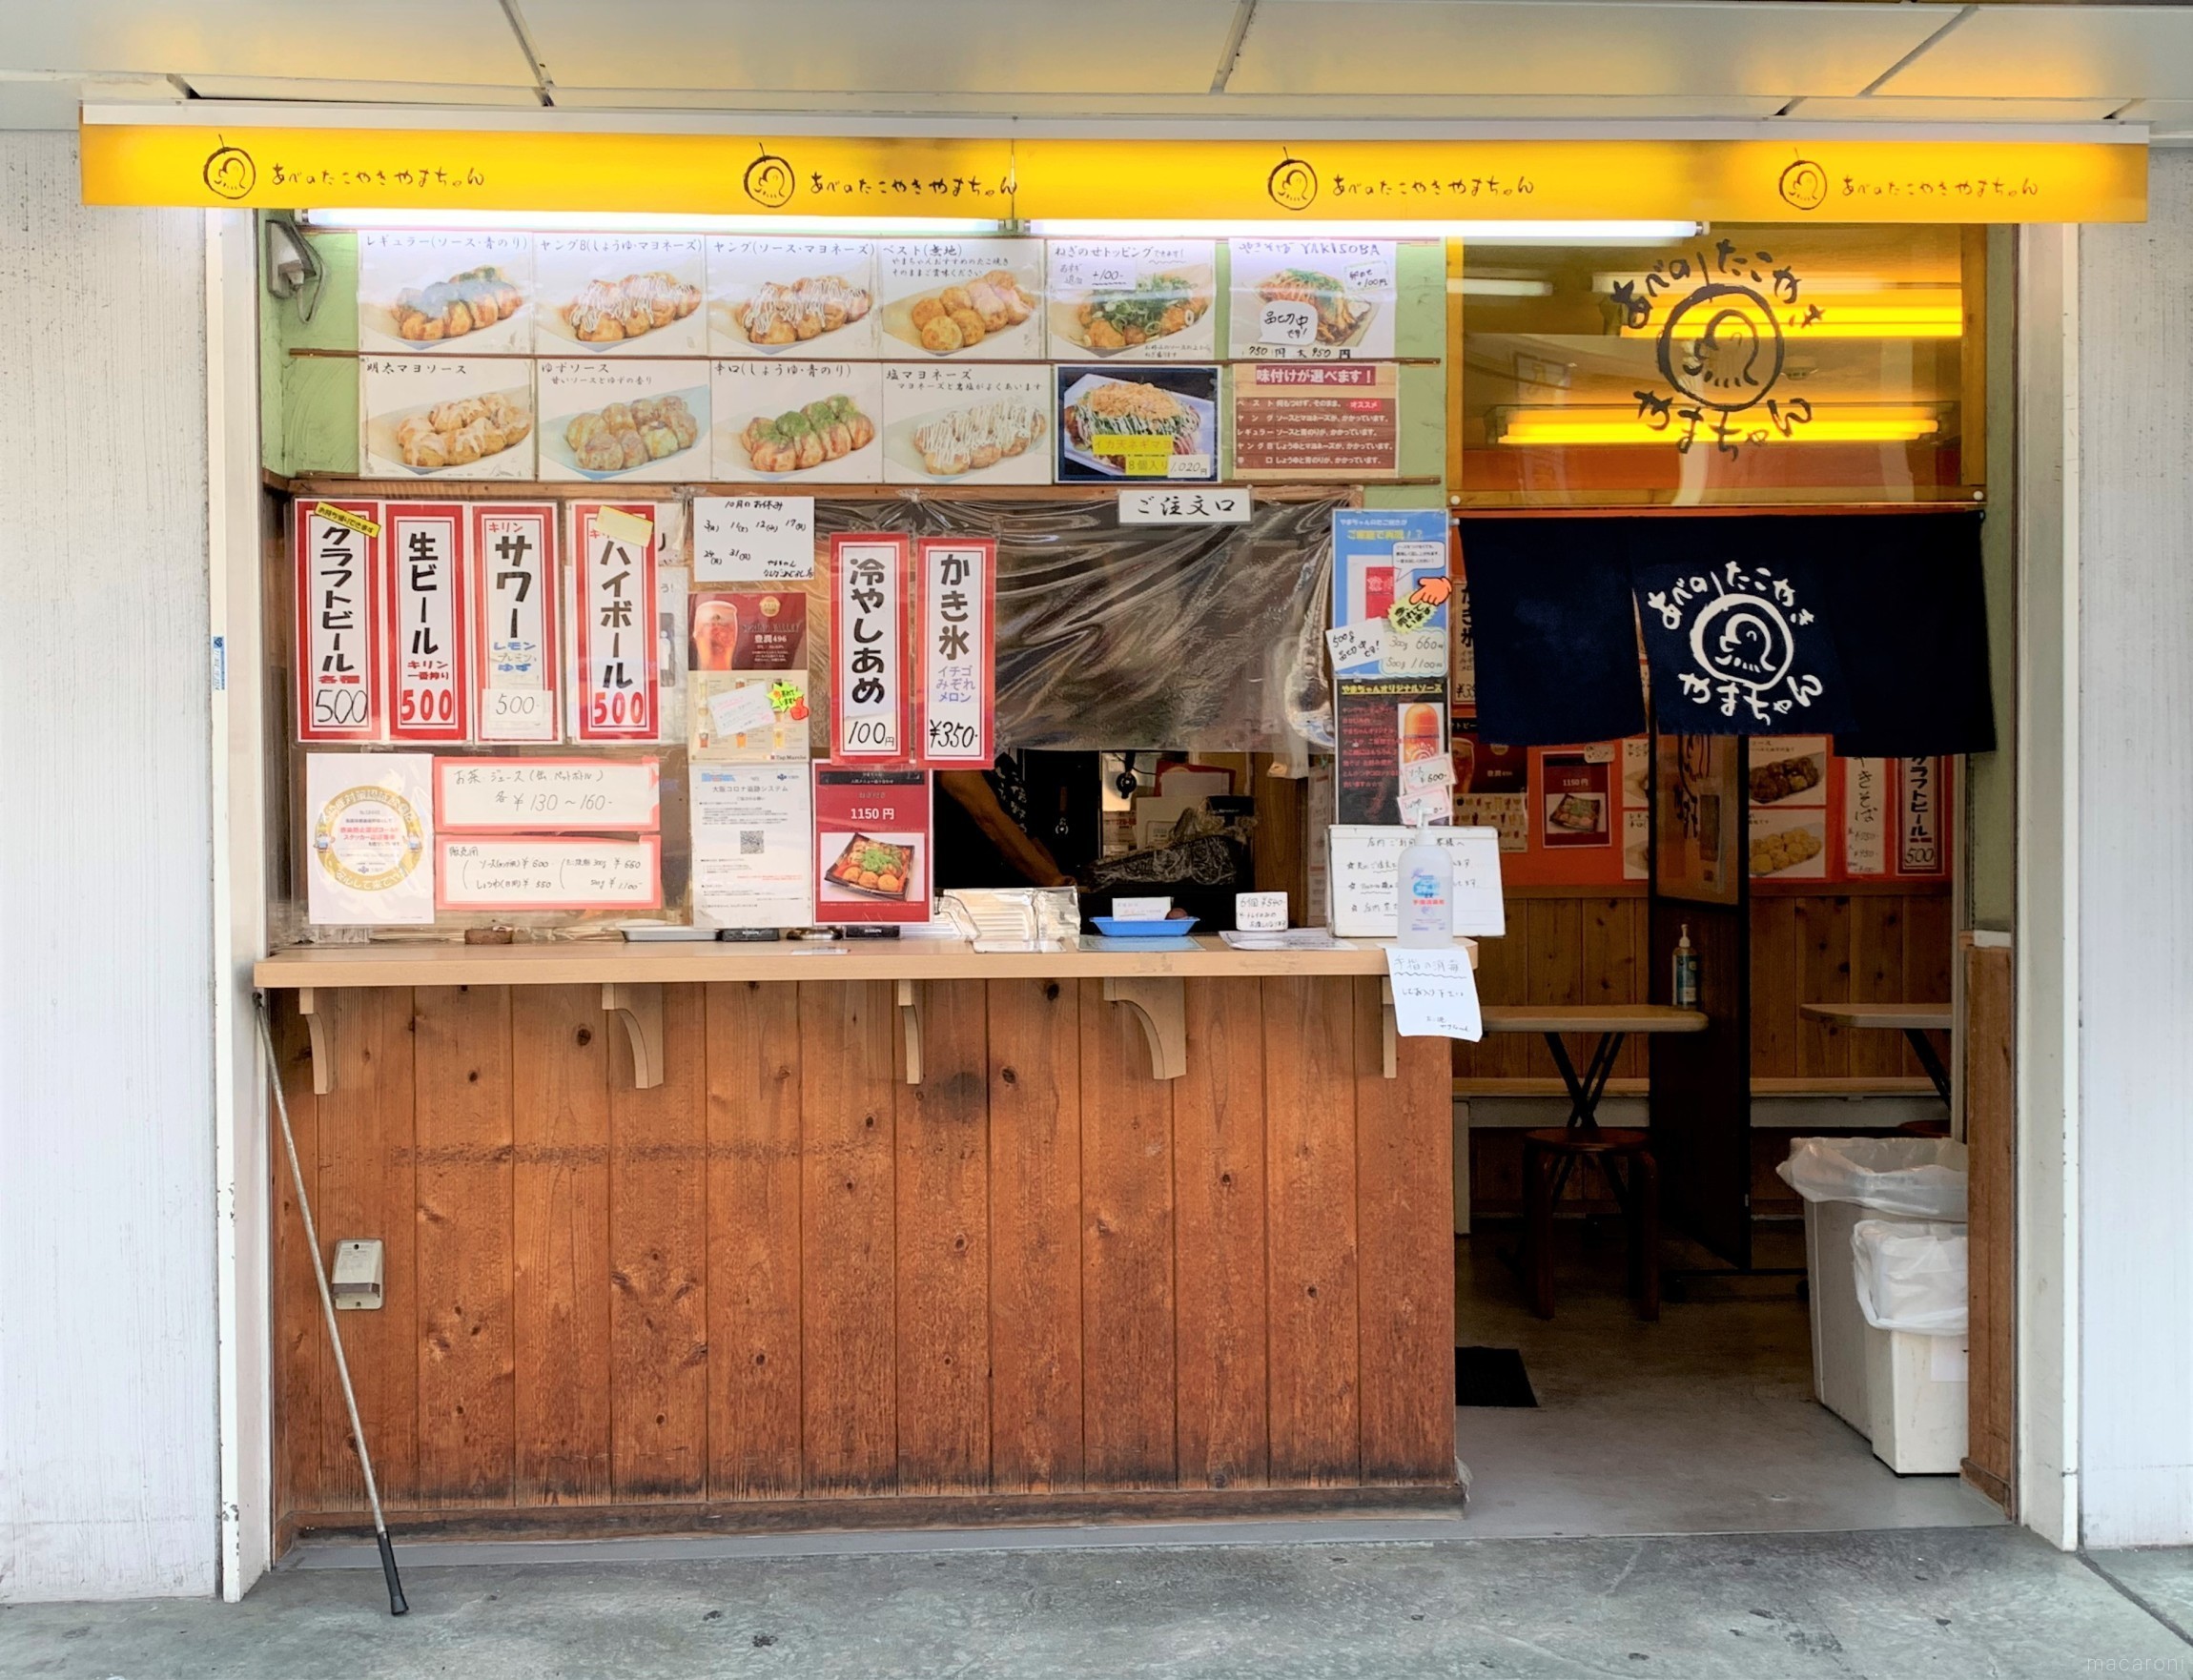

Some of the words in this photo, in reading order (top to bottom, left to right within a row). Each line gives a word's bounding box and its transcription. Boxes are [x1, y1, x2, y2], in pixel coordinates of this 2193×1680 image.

[1256, 369, 1371, 383] 味付けが選べます！
[1137, 495, 1236, 517] ご注文口
[488, 522, 523, 534] キリン
[319, 526, 356, 673] クラフトビール
[408, 531, 440, 656] 生ビール
[495, 534, 533, 639] サワー
[599, 541, 634, 688] ハイボール
[937, 553, 972, 661] かき氷
[849, 557, 887, 705] 冷やしあめ
[493, 641, 536, 651] レモン
[407, 659, 449, 670] キリン
[936, 666, 973, 678] イチゴ
[935, 678, 976, 690] みぞれ
[938, 691, 973, 704] メロン
[315, 688, 368, 725] 500
[400, 688, 453, 722] 500
[593, 691, 645, 725] 500
[847, 721, 895, 748] 100円
[851, 808, 880, 820] 1150
[882, 808, 895, 821] 円
